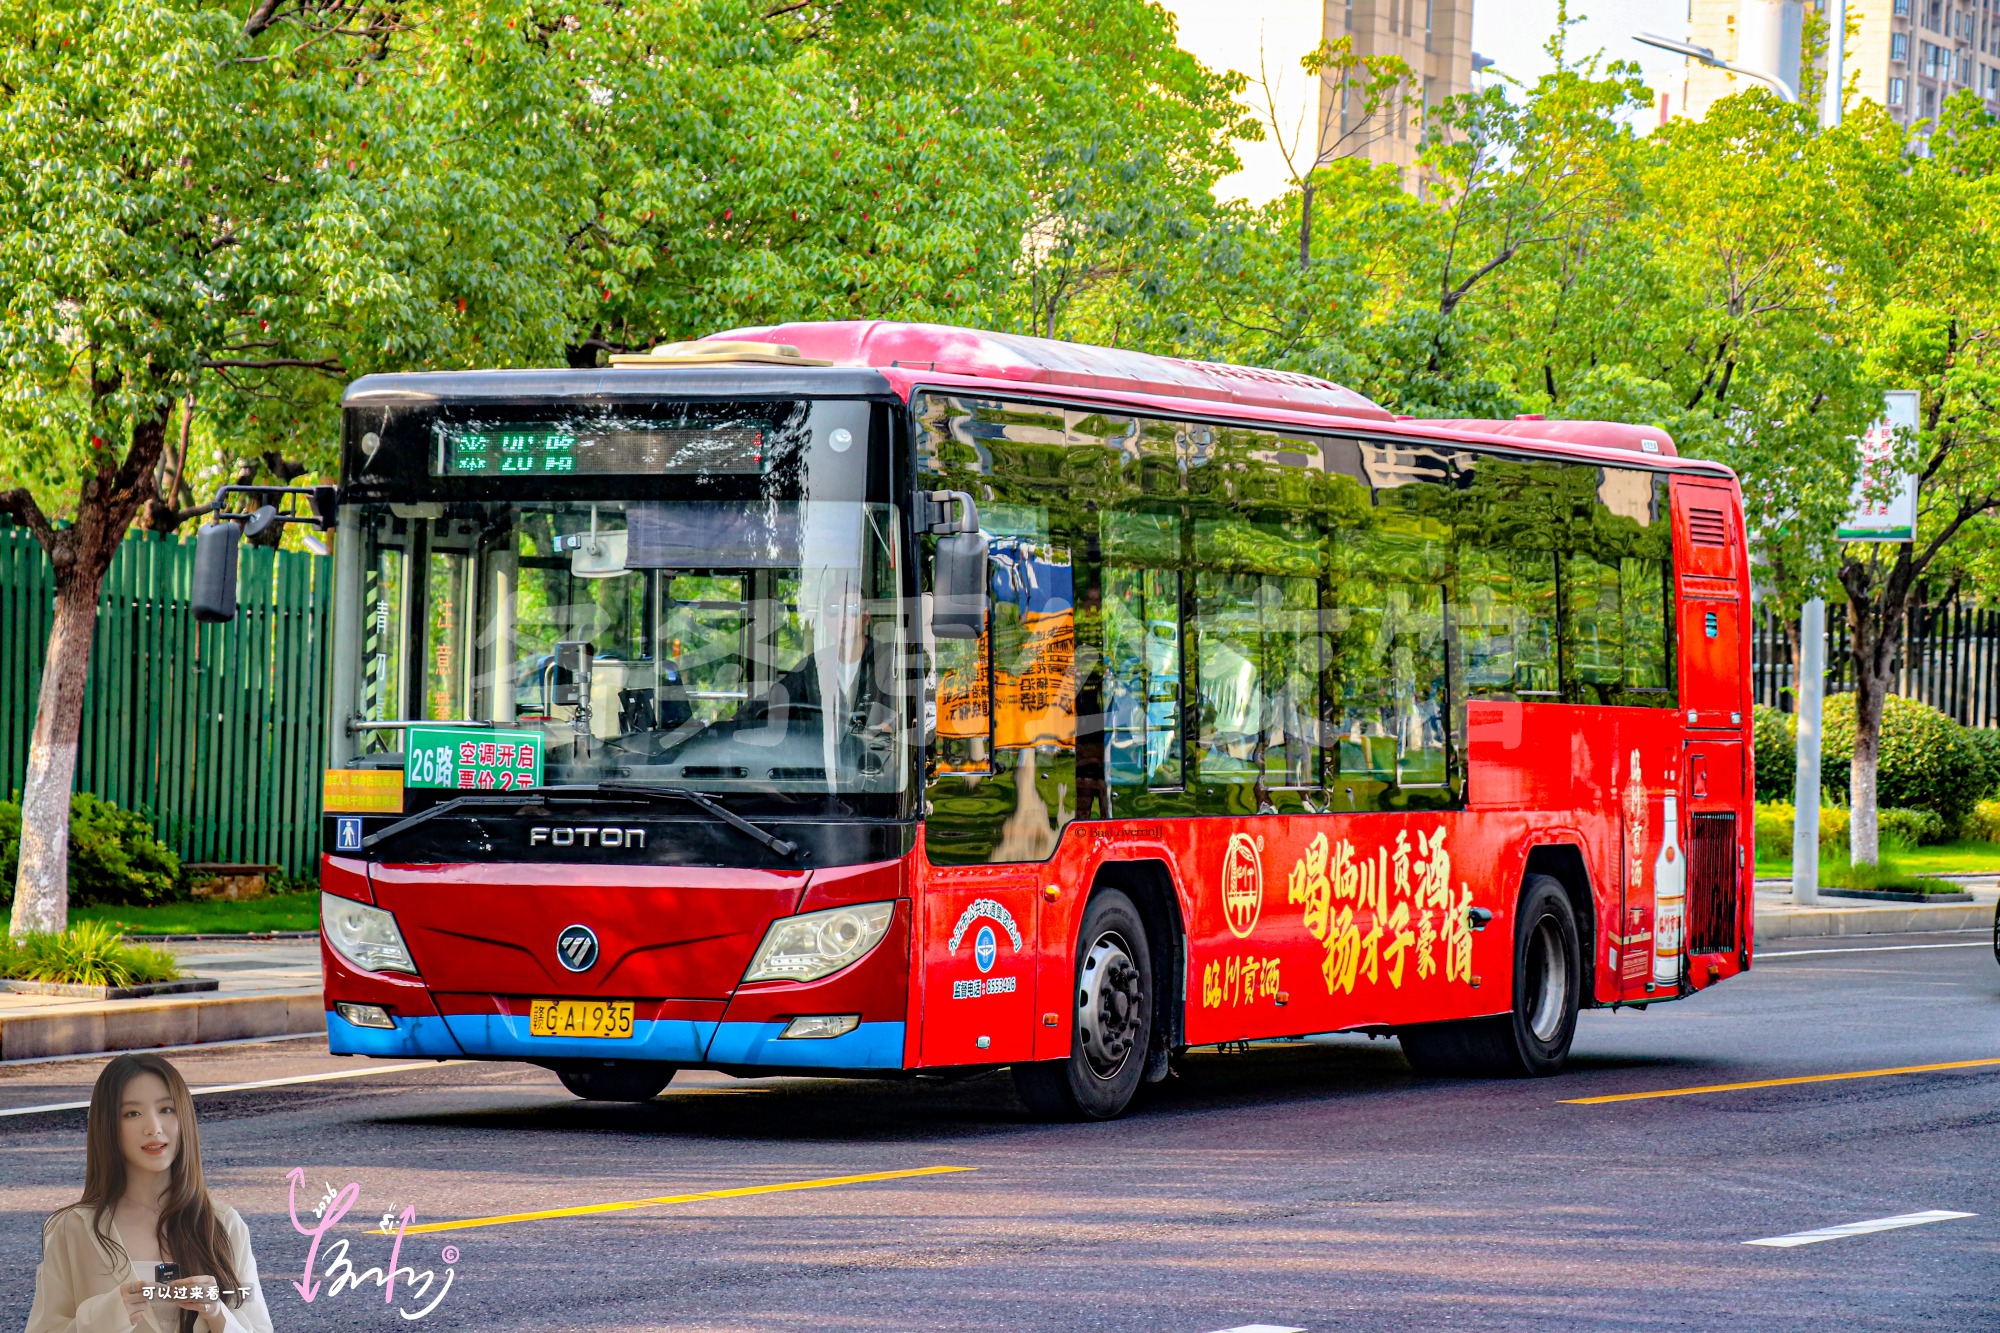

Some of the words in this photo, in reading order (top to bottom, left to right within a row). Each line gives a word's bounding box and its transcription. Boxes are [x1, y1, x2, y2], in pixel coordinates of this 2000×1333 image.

[411, 746, 454, 787] 26路
[458, 741, 535, 769] 空调开启
[457, 769, 534, 791] 票价2元
[530, 827, 646, 848] FOTON
